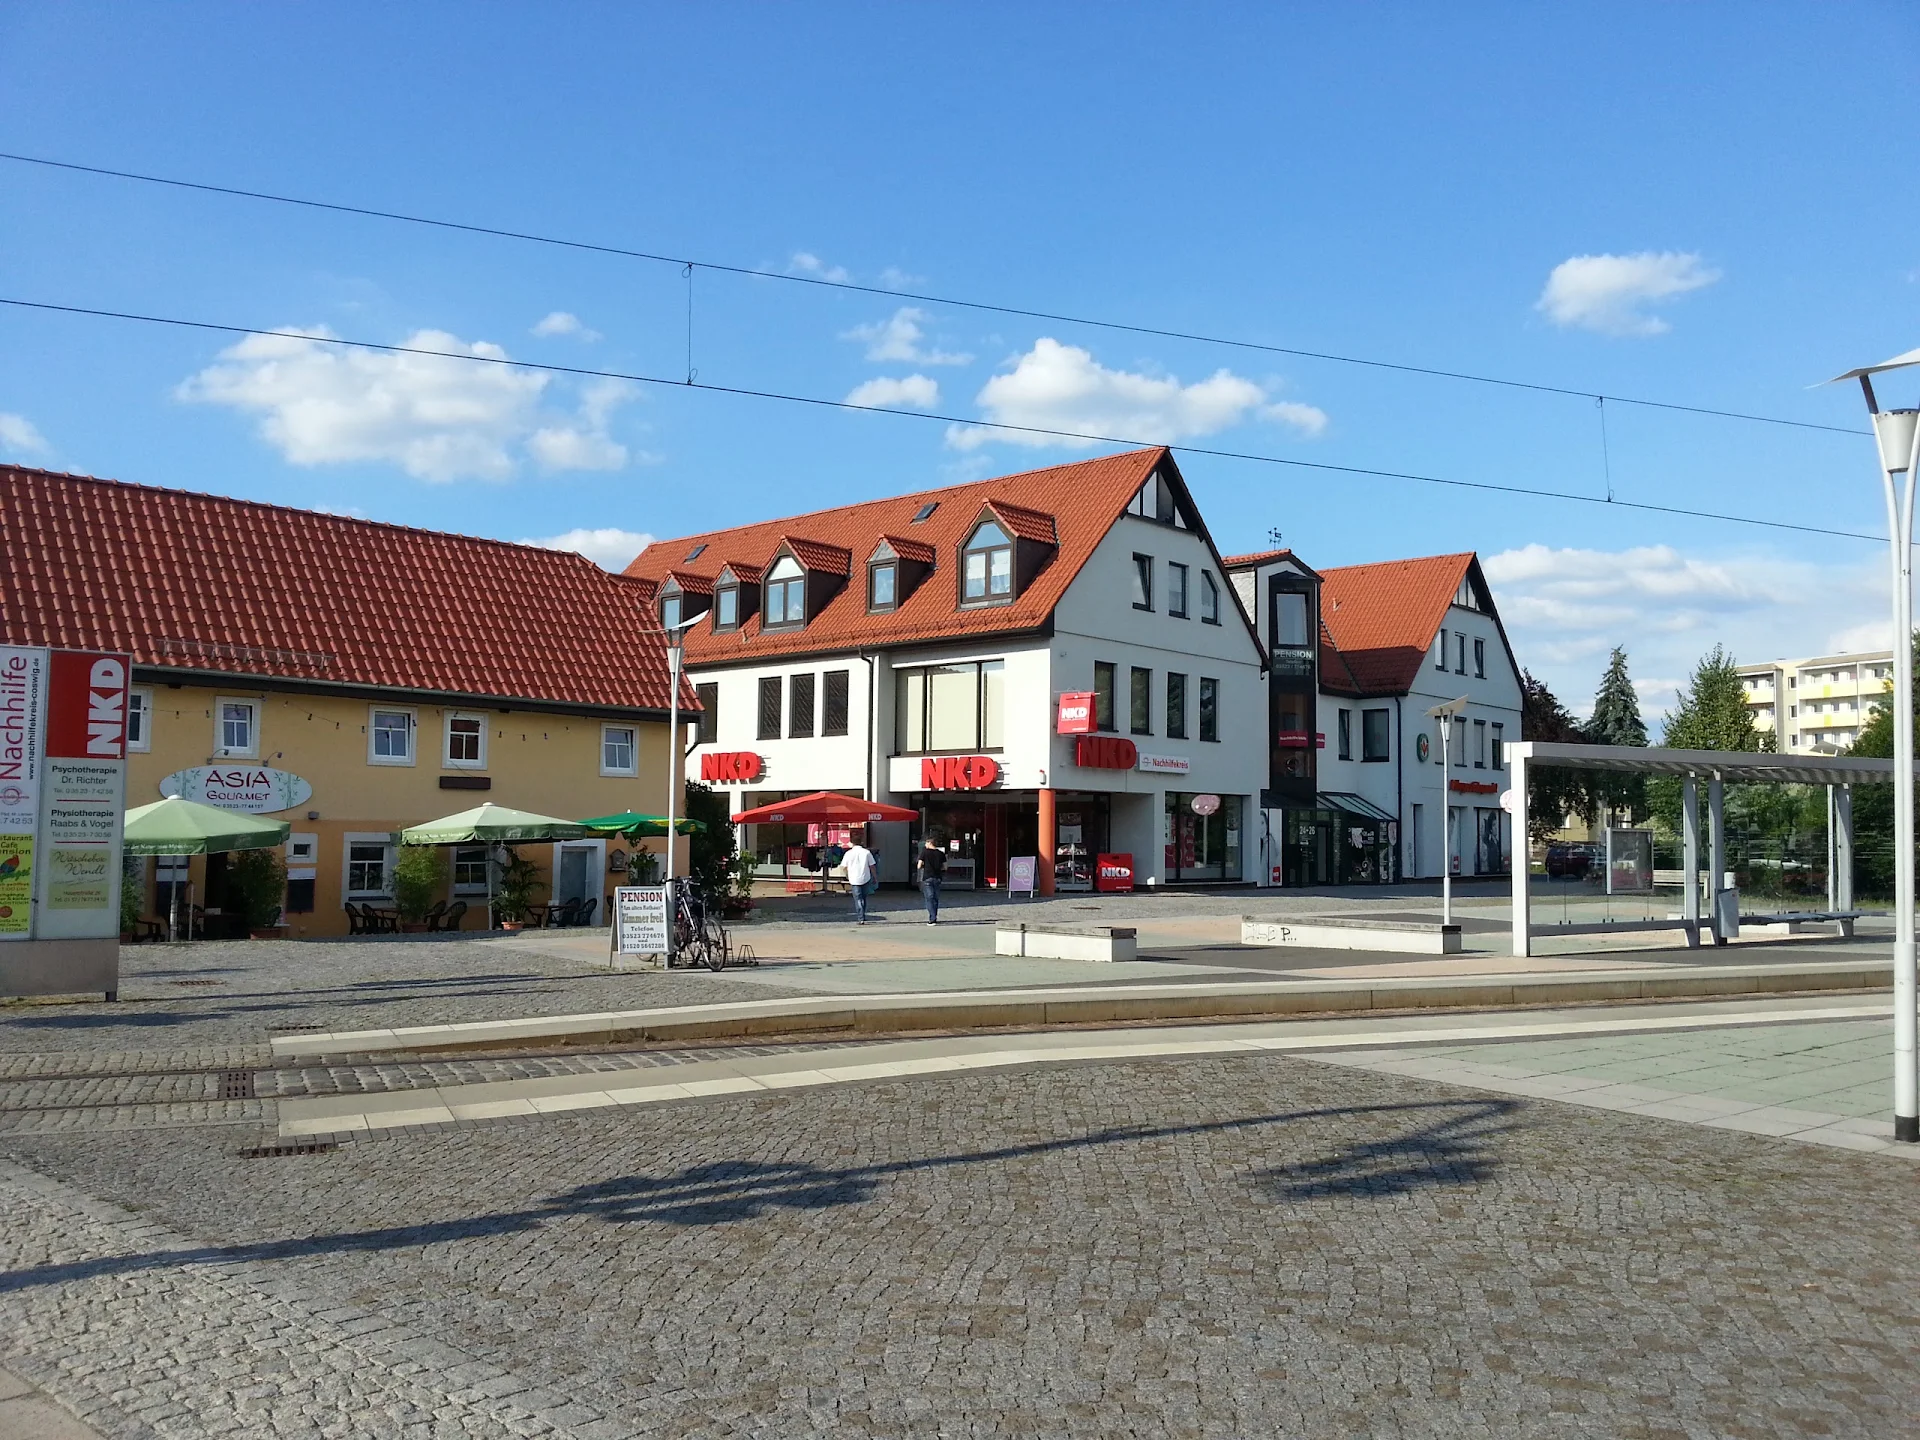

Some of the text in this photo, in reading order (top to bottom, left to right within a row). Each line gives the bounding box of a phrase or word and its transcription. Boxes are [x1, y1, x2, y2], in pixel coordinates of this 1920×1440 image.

[1274, 650, 1312, 659] PENSION
[86, 658, 125, 756] NKD
[1061, 706, 1088, 719] NKD
[0, 656, 27, 781] Nachhilfe
[1076, 735, 1137, 770] NKD
[701, 751, 762, 781] NKD
[1152, 757, 1189, 769] Nachhilfekreis
[52, 765, 118, 775] Psychotherapie
[922, 756, 997, 788] NKD
[61, 775, 108, 785] Dr. Richter
[205, 770, 271, 789] ASIA
[206, 790, 271, 801] GOURMET
[51, 809, 114, 818] Physiotherapie
[769, 814, 784, 822] NKD
[868, 813, 882, 821] NKD
[50, 820, 114, 829] Raabs & Vogel
[64, 862, 106, 876] Wendl
[1101, 866, 1131, 877] NKD
[620, 892, 662, 902] PENSION
[621, 912, 664, 924] Zimmer frei!
